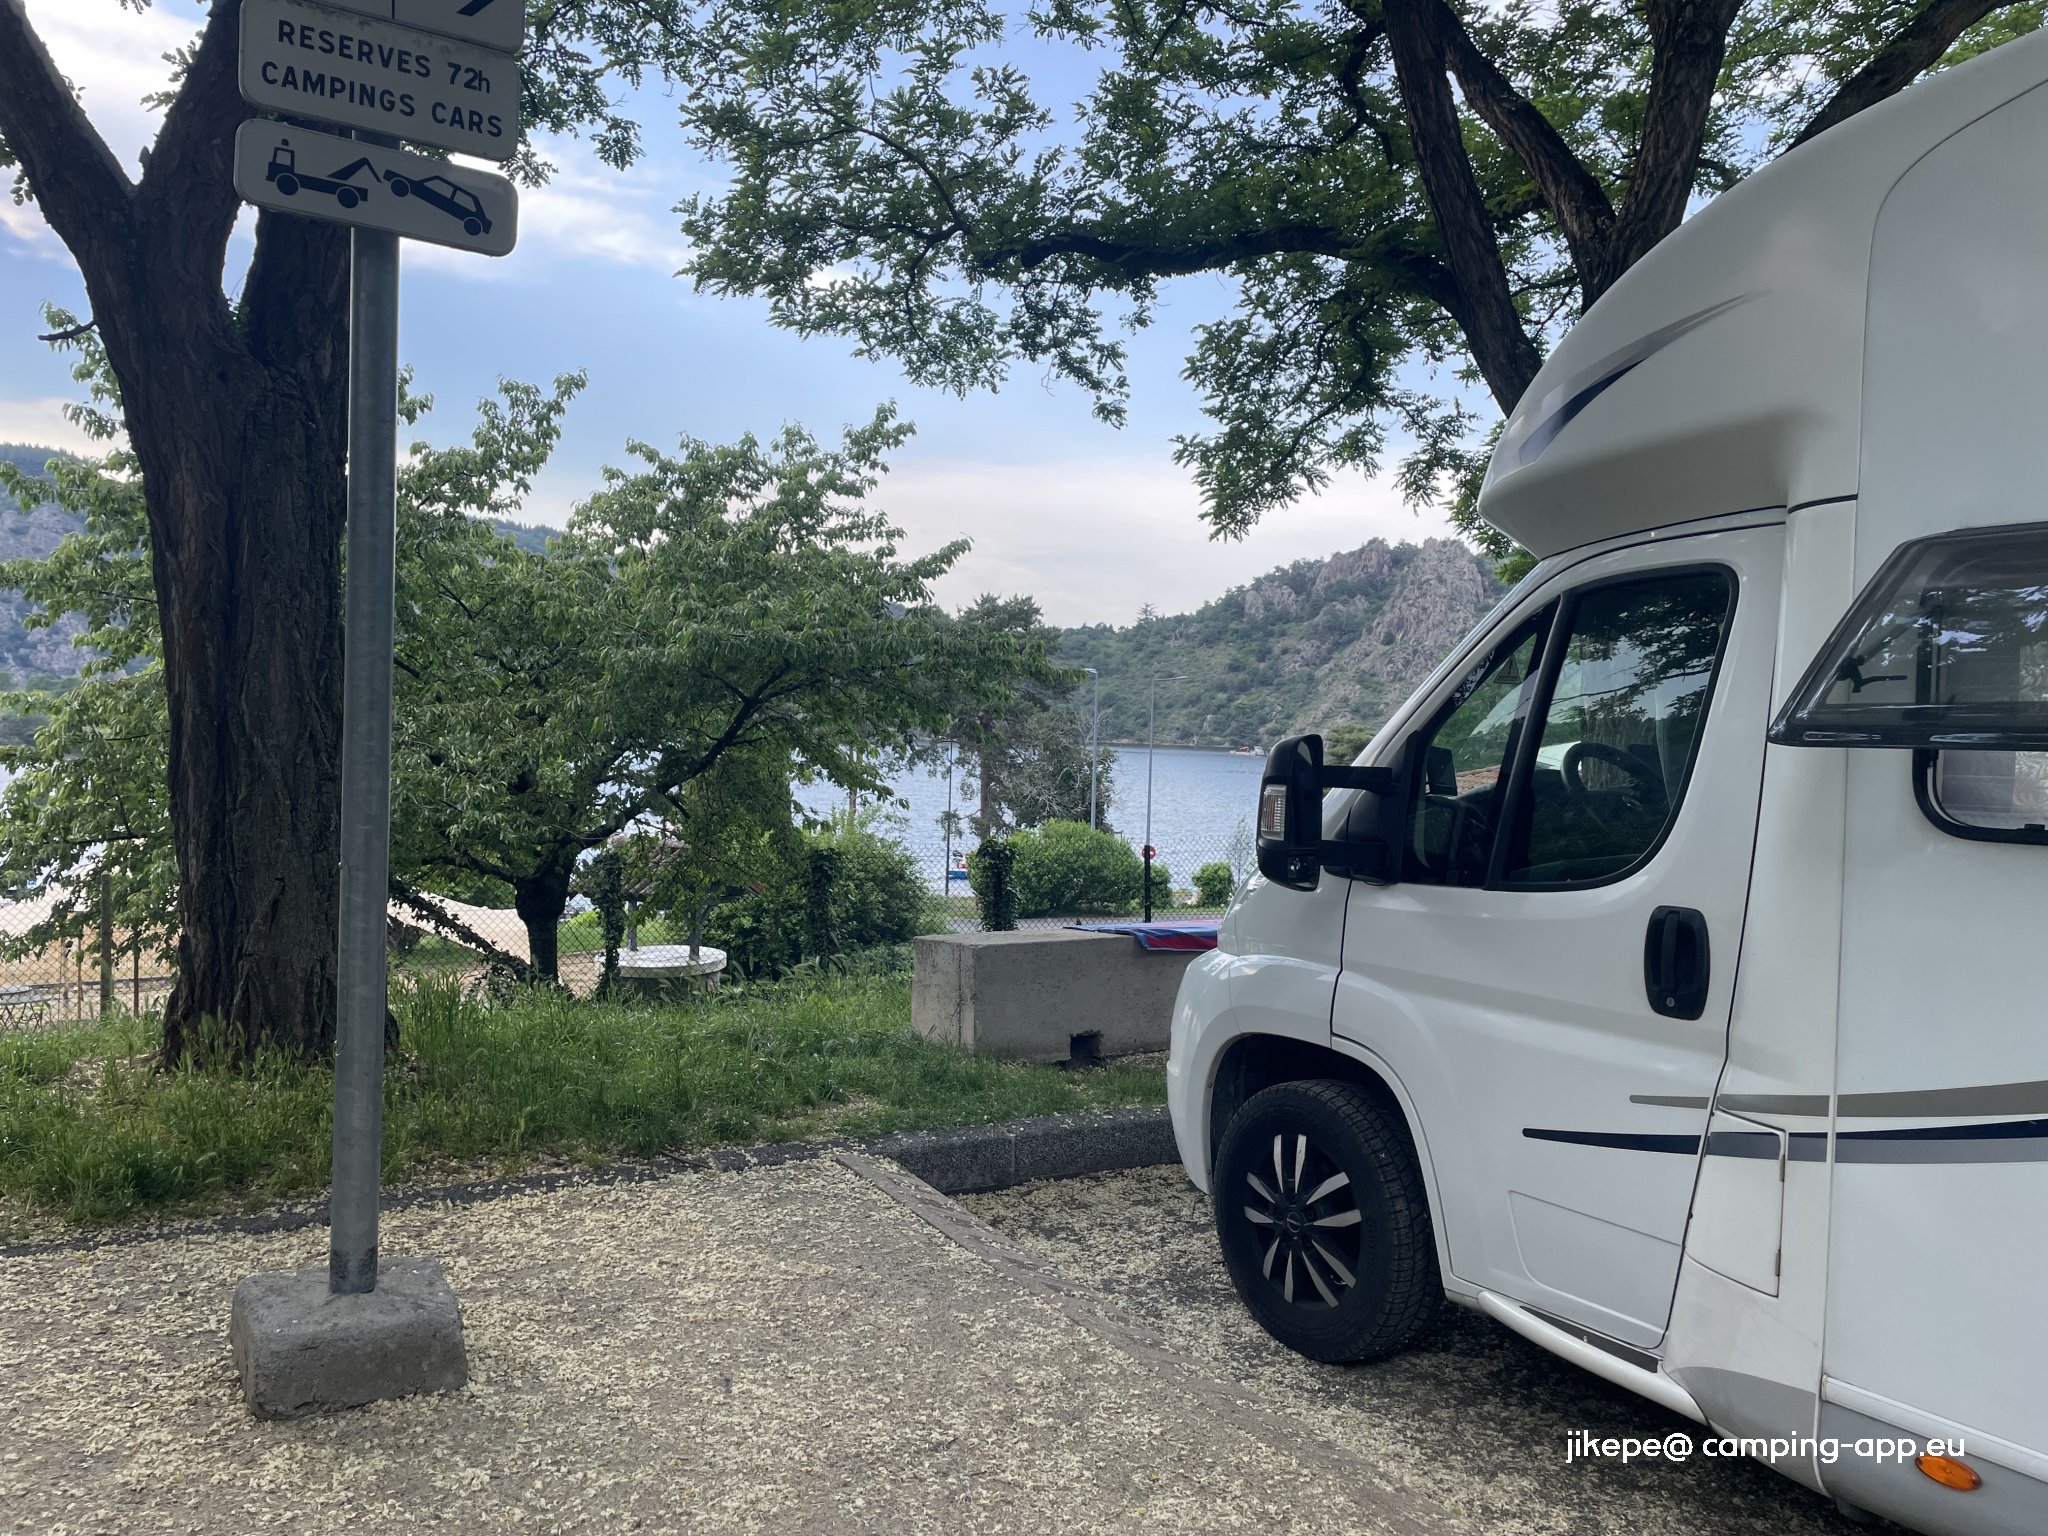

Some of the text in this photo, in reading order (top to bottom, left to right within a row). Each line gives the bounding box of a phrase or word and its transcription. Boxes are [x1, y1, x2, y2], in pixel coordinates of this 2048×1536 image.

[278, 19, 491, 94] RESERVES 72h
[261, 61, 503, 138] CAMPINGS CARS
